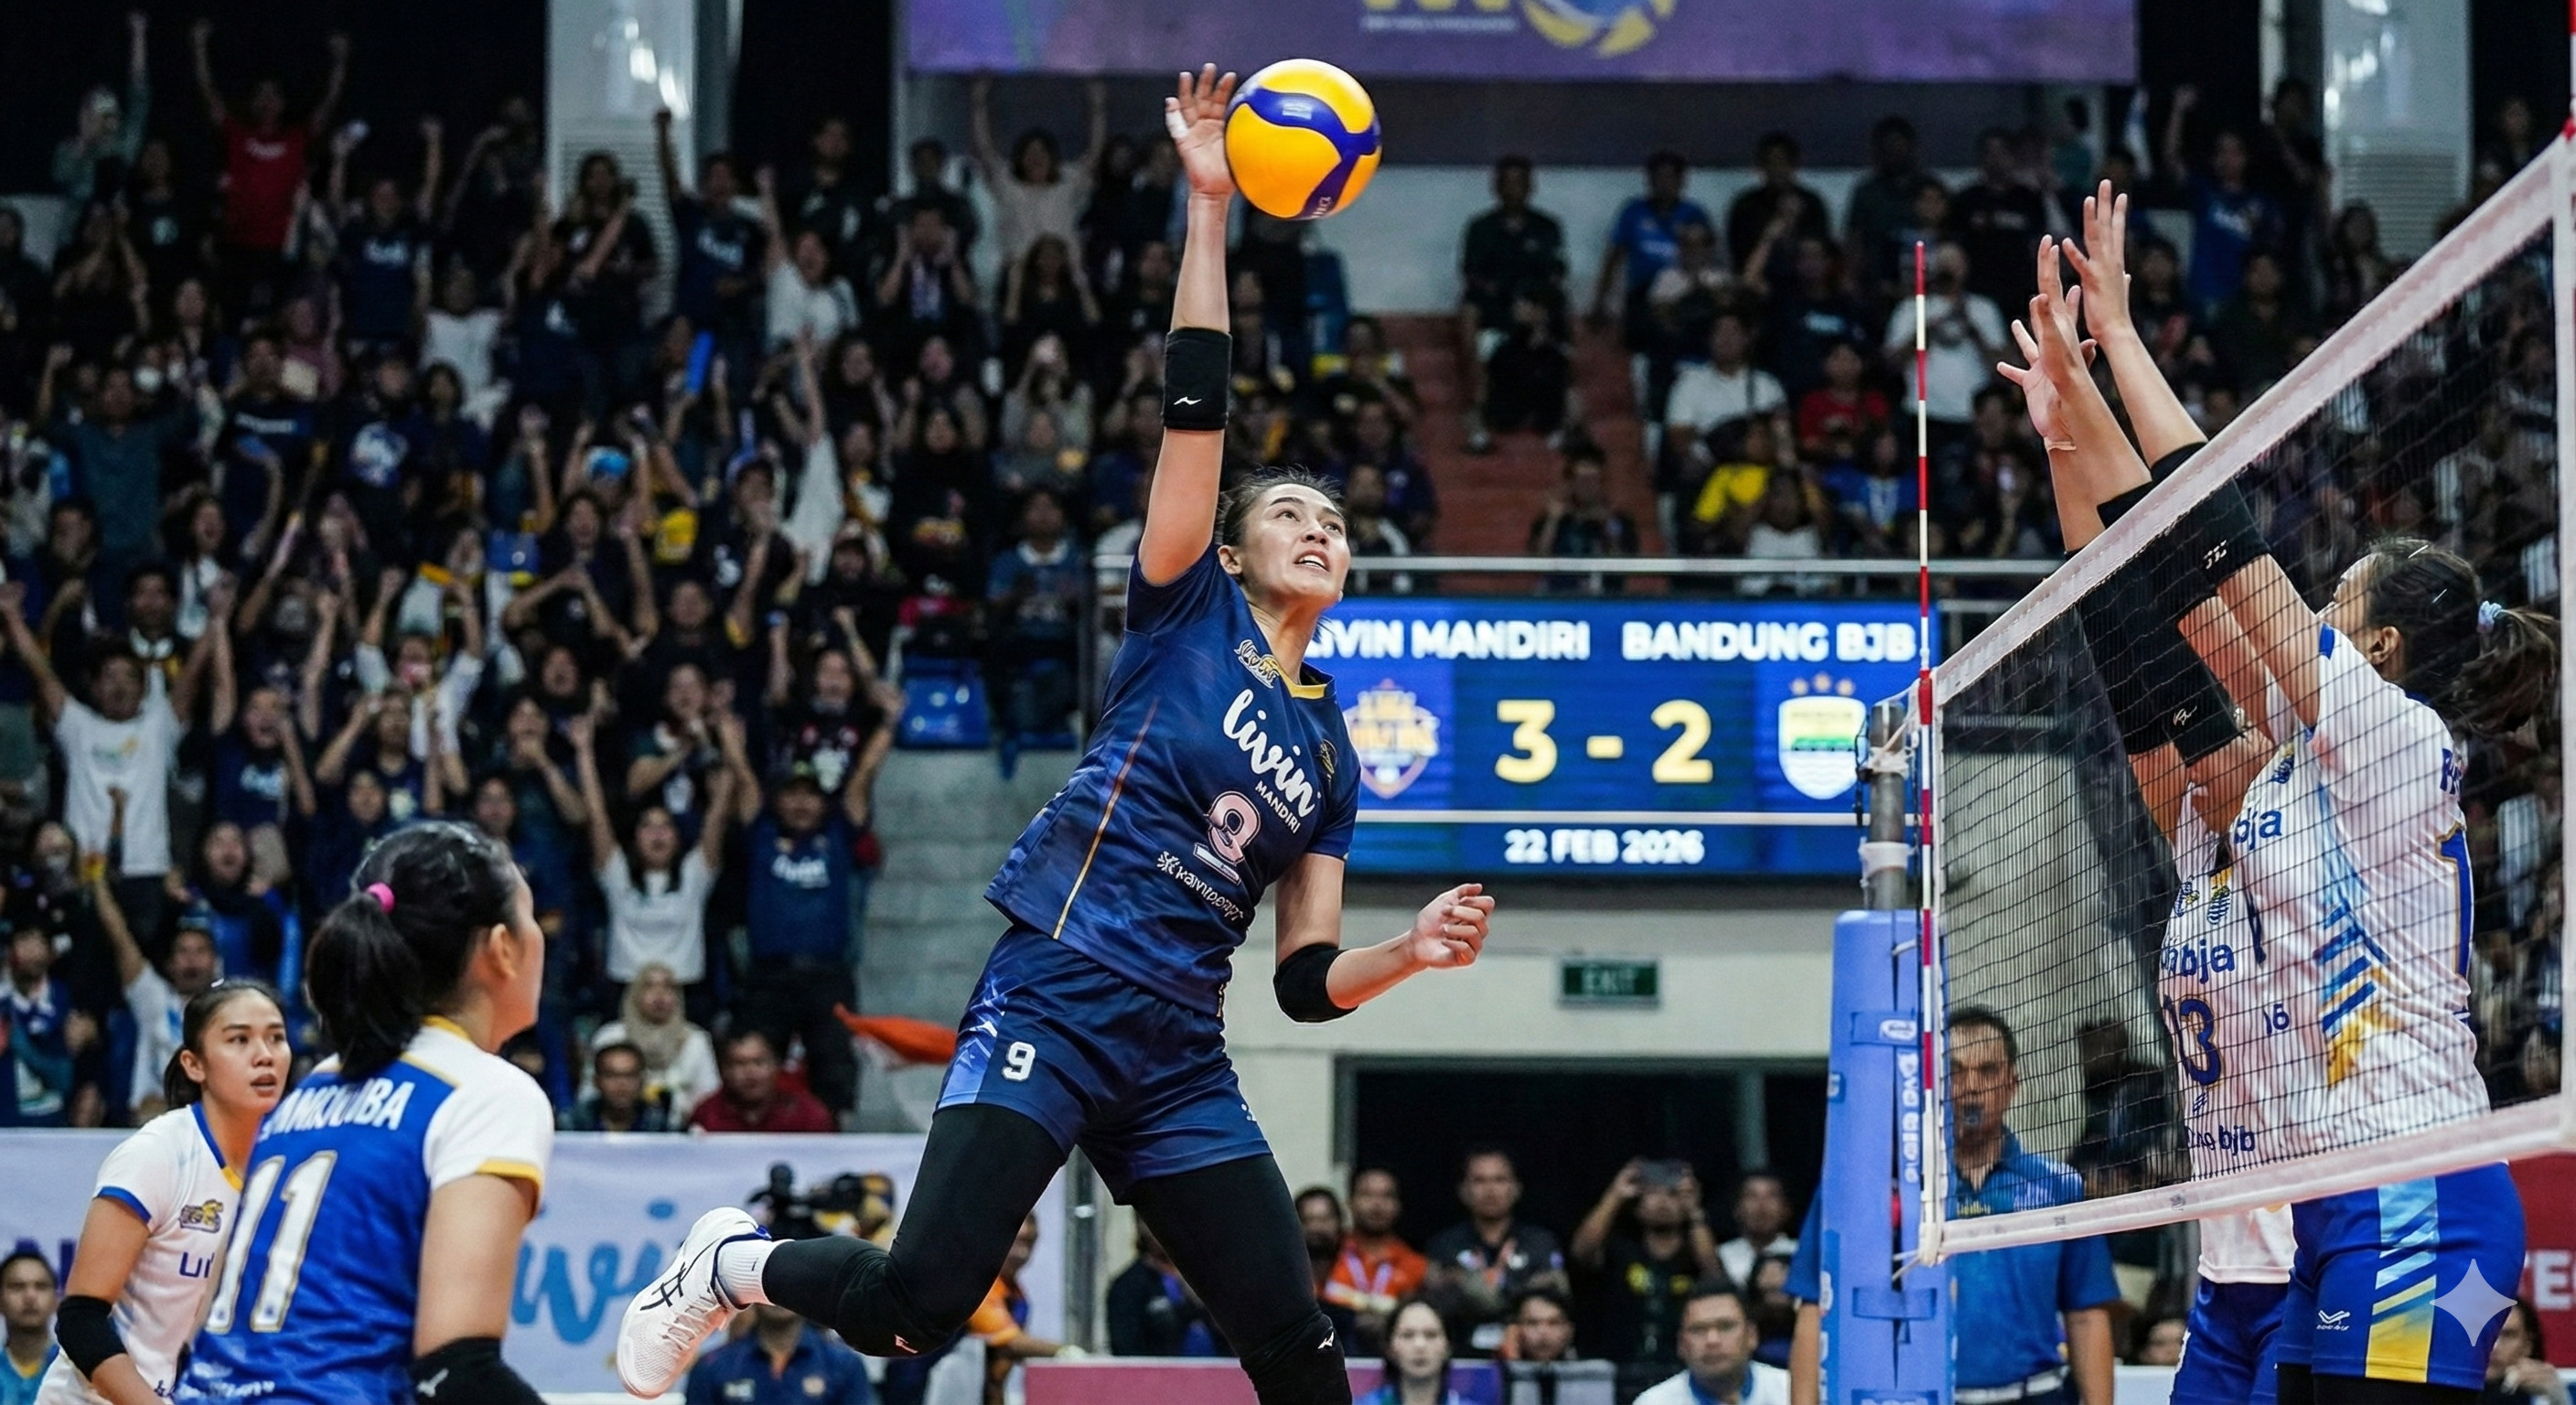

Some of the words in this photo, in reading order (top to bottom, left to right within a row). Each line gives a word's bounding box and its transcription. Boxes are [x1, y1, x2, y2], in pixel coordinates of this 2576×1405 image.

[1411, 619, 1591, 660] MANDIRI
[1622, 621, 1830, 662] BANDUNG
[1836, 622, 1916, 662] BJB
[1495, 699, 1557, 784] 3
[1650, 698, 1713, 784] 2
[1254, 780, 1302, 834] MANDIRI
[1504, 829, 1548, 863] 22
[1551, 829, 1619, 863] FEB
[1621, 829, 1705, 864] 2026
[1002, 1041, 1036, 1081] 9
[203, 1150, 338, 1334] 11
